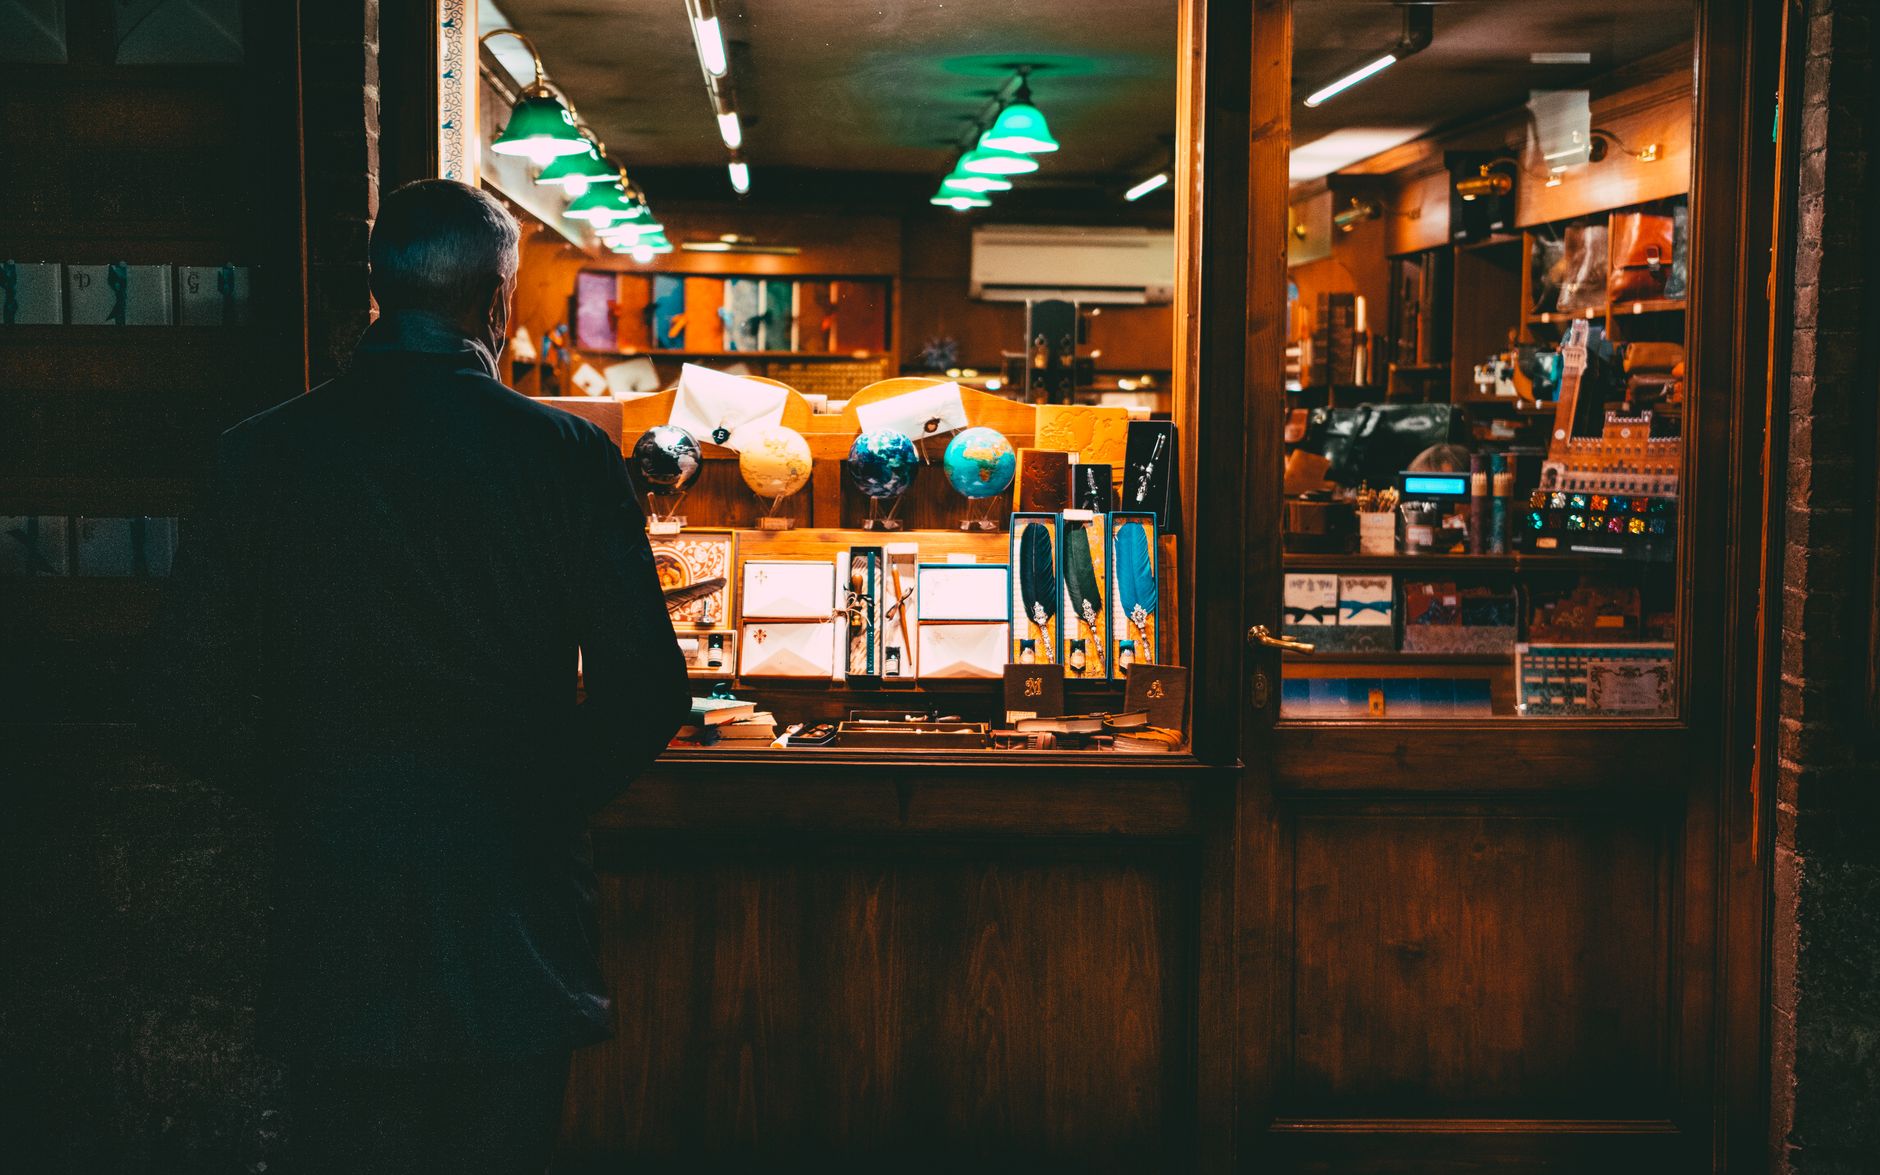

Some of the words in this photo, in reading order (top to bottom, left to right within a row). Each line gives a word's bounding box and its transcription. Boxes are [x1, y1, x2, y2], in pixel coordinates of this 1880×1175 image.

[717, 430, 725, 440] E
[1025, 677, 1042, 697] M
[1147, 679, 1164, 698] A
